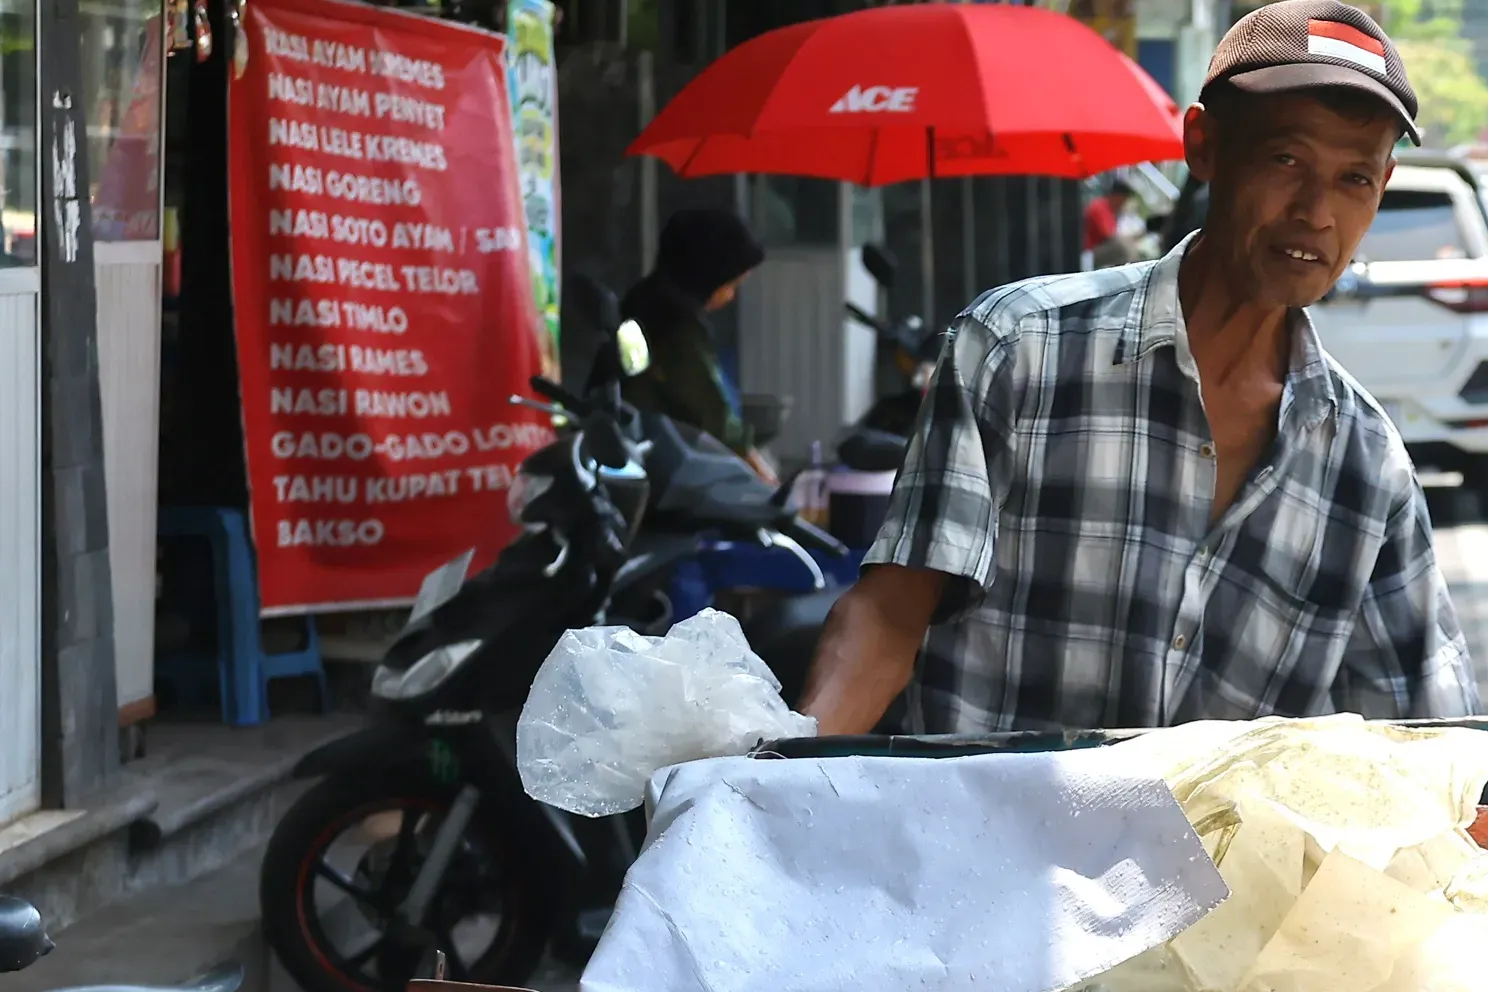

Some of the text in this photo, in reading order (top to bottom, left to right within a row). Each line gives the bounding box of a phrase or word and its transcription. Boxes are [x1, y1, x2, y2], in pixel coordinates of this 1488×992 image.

[263, 26, 310, 62] NASI
[312, 40, 366, 74] AYAM
[269, 72, 314, 106] NASI
[316, 83, 370, 117] AYAM
[828, 83, 919, 113] ACE
[270, 118, 319, 151] NASI
[320, 127, 363, 159] LELE
[271, 164, 423, 206] NASI GORENG
[272, 209, 329, 239] NASI
[331, 214, 387, 247] SOTO
[392, 223, 454, 252] AYAM
[272, 254, 478, 295] NASI PECEL TELOR
[271, 299, 407, 333] NASI TIMLO
[271, 343, 428, 375] NASI RAMES
[271, 388, 450, 417] NASI RAWON
[271, 431, 469, 462] GADO-GADO
[272, 475, 357, 503] TAHU
[366, 469, 461, 502] KUPAT
[277, 519, 384, 547] BAKSO
